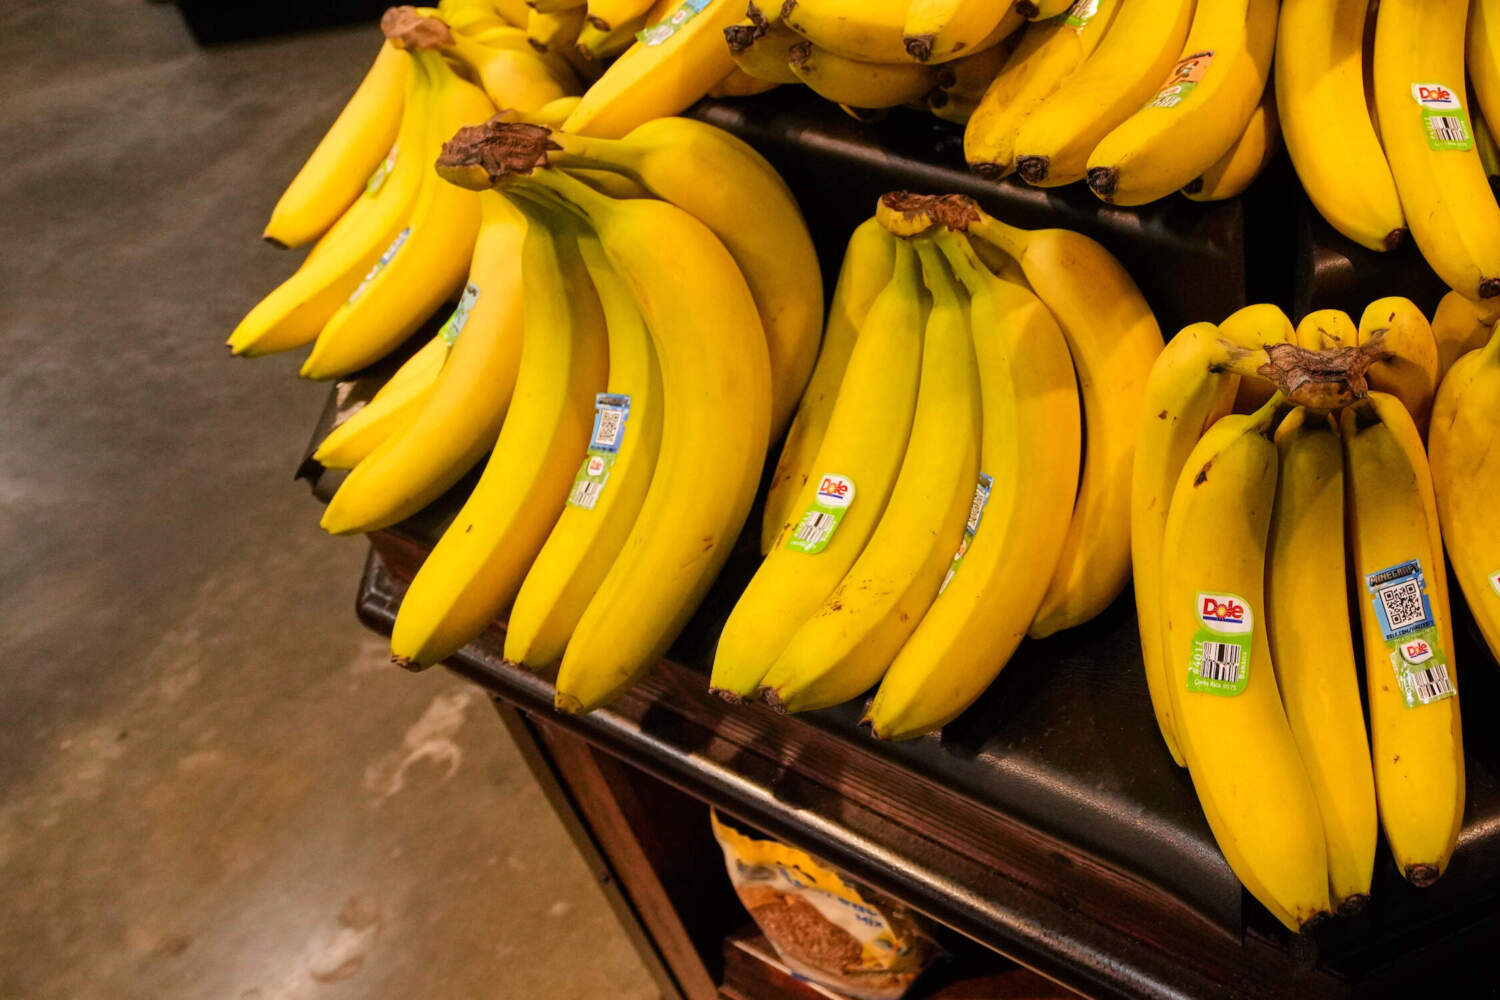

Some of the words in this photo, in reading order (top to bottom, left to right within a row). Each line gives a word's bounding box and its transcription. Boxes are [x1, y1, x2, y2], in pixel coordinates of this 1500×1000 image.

[1419, 87, 1450, 101] Dole
[820, 478, 848, 496] Dole
[1369, 562, 1420, 587] MINECRAFT
[1203, 598, 1244, 619] Dole
[1407, 641, 1428, 657] Dole
